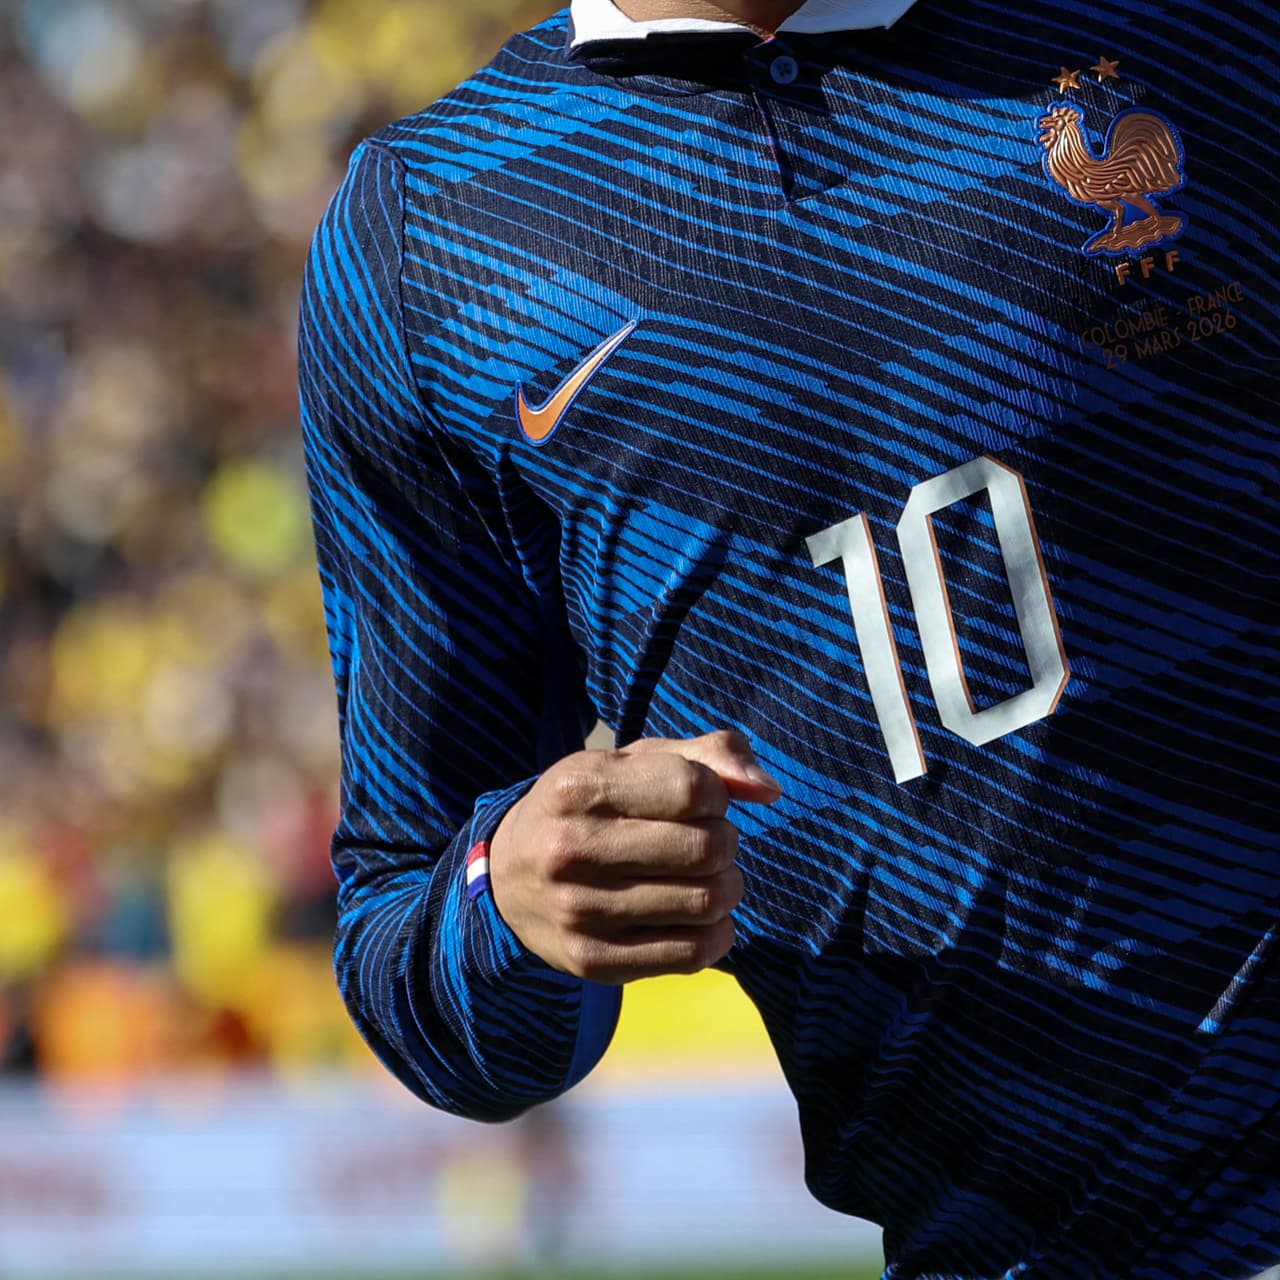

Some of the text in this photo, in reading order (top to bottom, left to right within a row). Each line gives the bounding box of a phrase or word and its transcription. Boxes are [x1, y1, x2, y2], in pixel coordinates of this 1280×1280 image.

[1081, 307, 1169, 350] COLOMBIE
[1187, 280, 1245, 317] FRANCE
[1102, 310, 1237, 370] 29 MARS 2026
[805, 454, 1071, 784] 10
